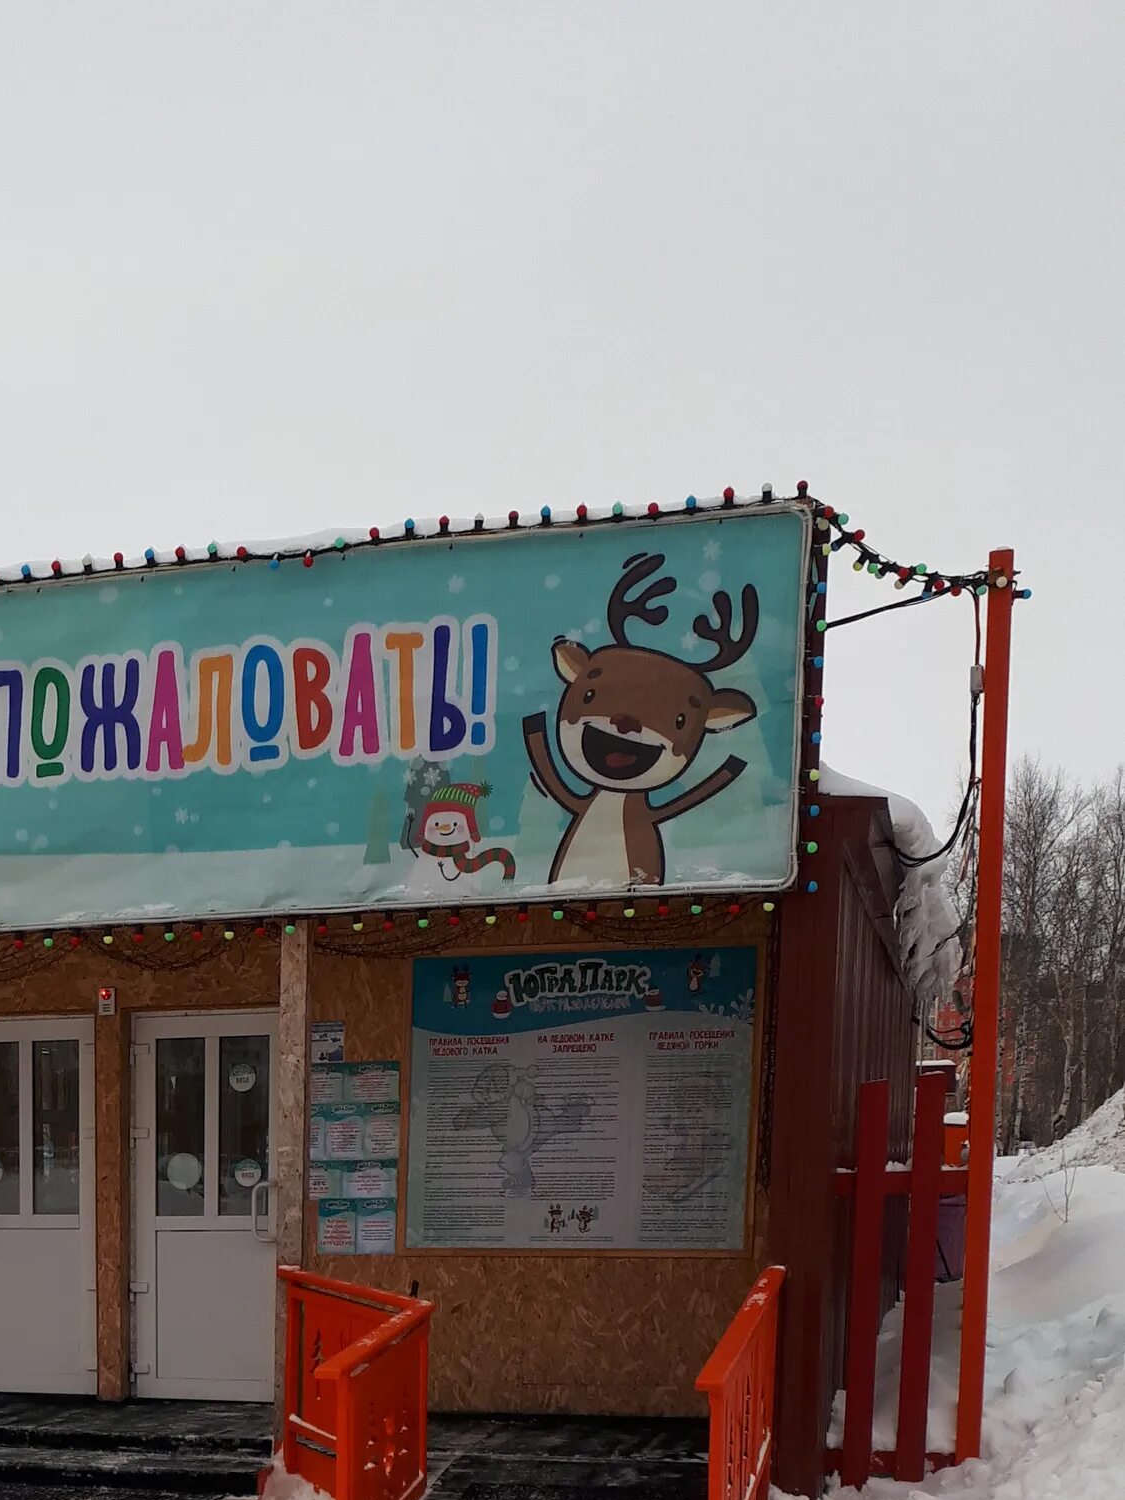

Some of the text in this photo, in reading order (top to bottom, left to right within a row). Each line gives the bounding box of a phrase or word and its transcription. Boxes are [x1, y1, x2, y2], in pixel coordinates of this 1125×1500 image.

[429, 1036, 509, 1046] ПРАВИЛА ПОСЕЩЕНИЯ
[537, 1033, 615, 1044] НА ЛЕДОВОМ КАТКЕ
[648, 1030, 735, 1041] ПРАВИЛА ПОСЕЩЕНИЯ
[552, 1043, 597, 1053] ЗАПРЕЩЕНО
[656, 1040, 719, 1051] ЛЕДЯНОЙ ГОРКИ
[432, 1046, 498, 1057] ЛЕДОВОГО КАТКА
